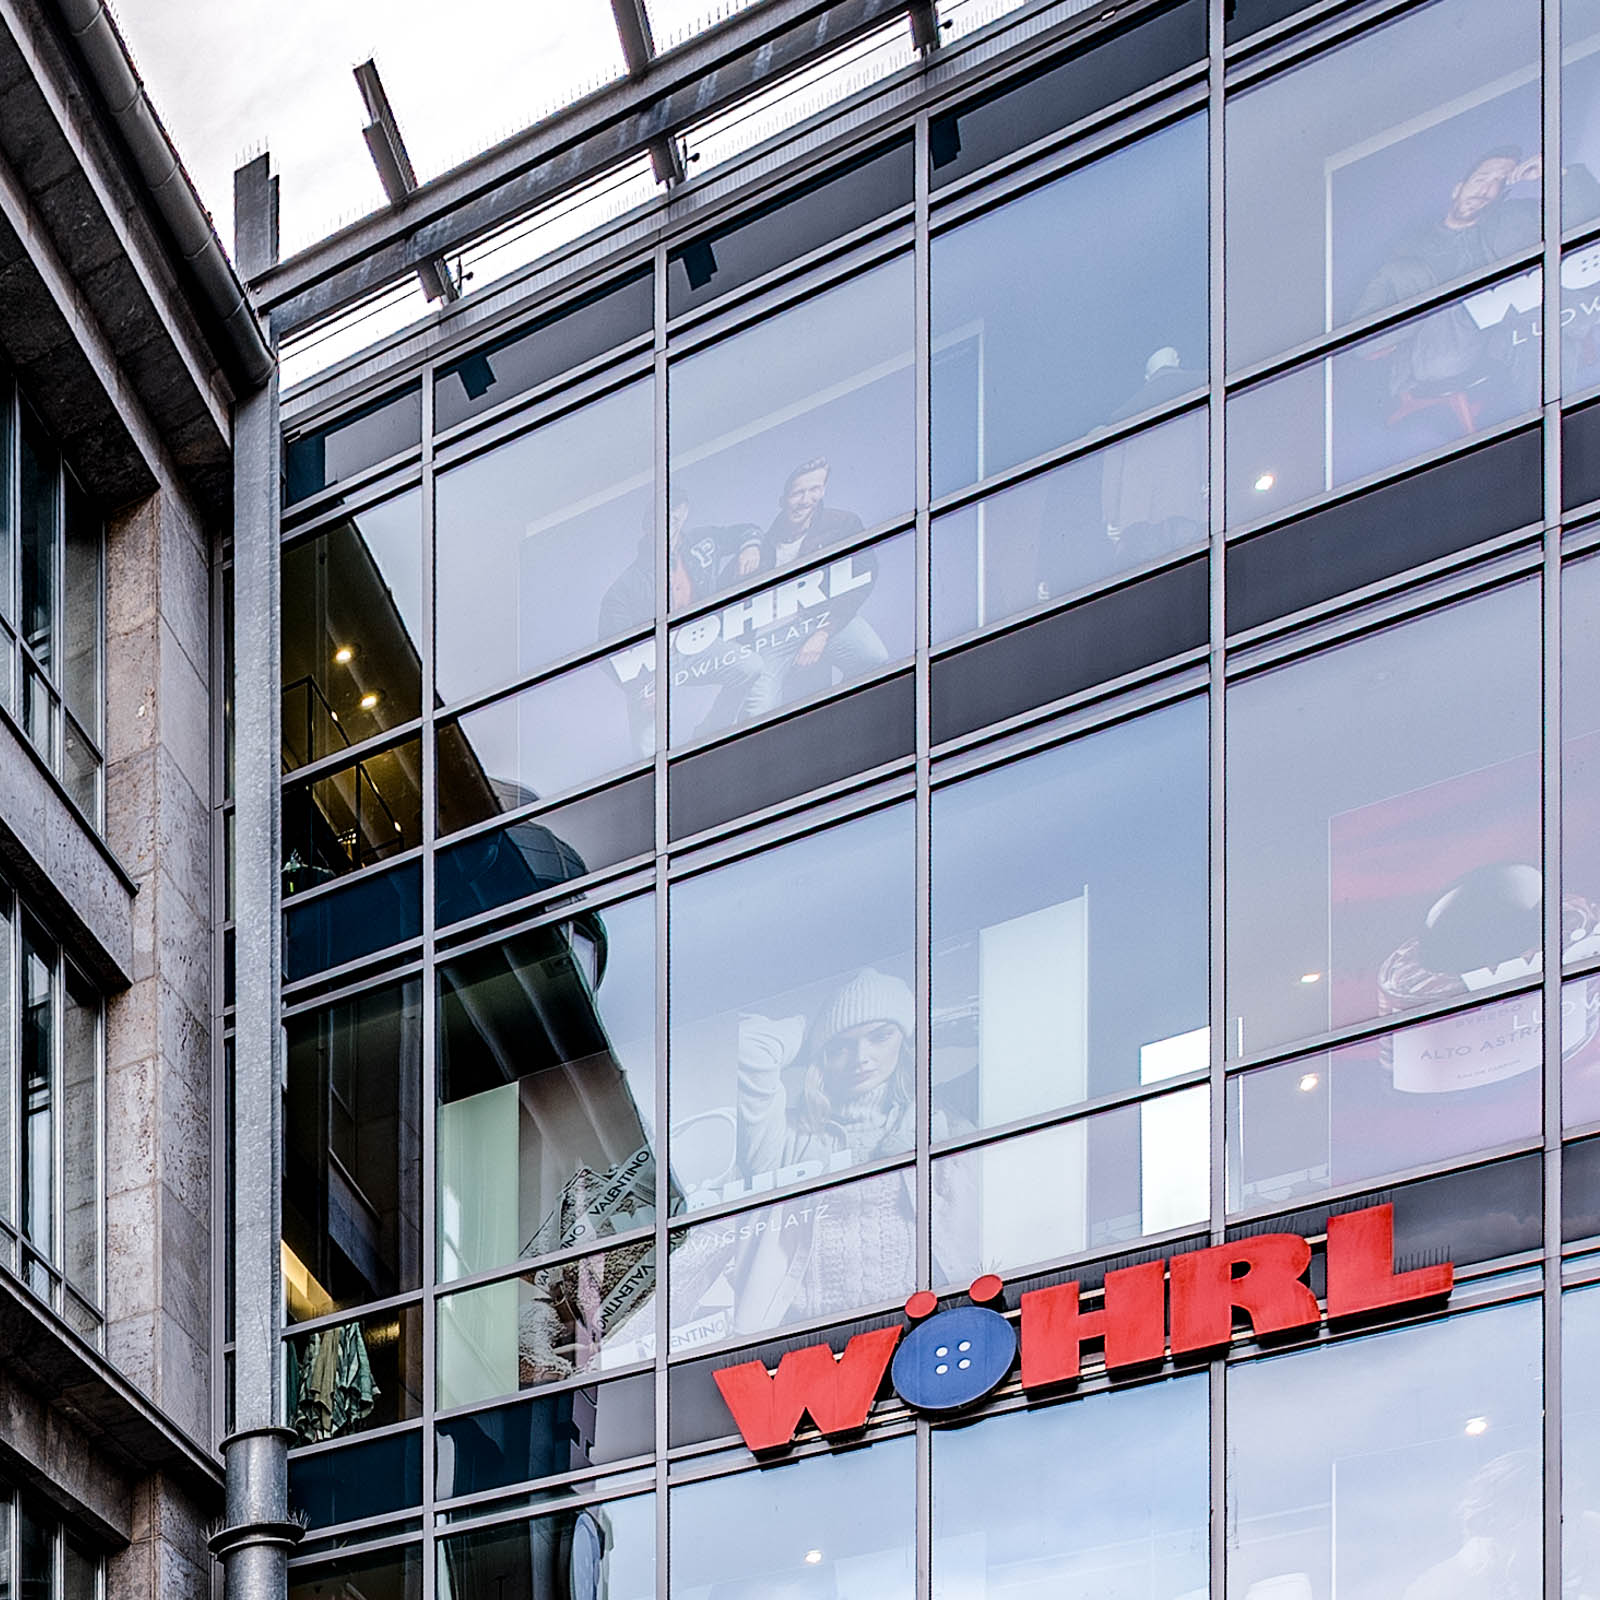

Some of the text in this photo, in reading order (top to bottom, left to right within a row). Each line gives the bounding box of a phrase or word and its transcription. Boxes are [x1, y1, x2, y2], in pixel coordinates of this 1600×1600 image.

[641, 611, 831, 698] LDWIGSPLATZ
[589, 1150, 650, 1217] VALENTINO
[713, 1201, 1454, 1456] WÖHRL
